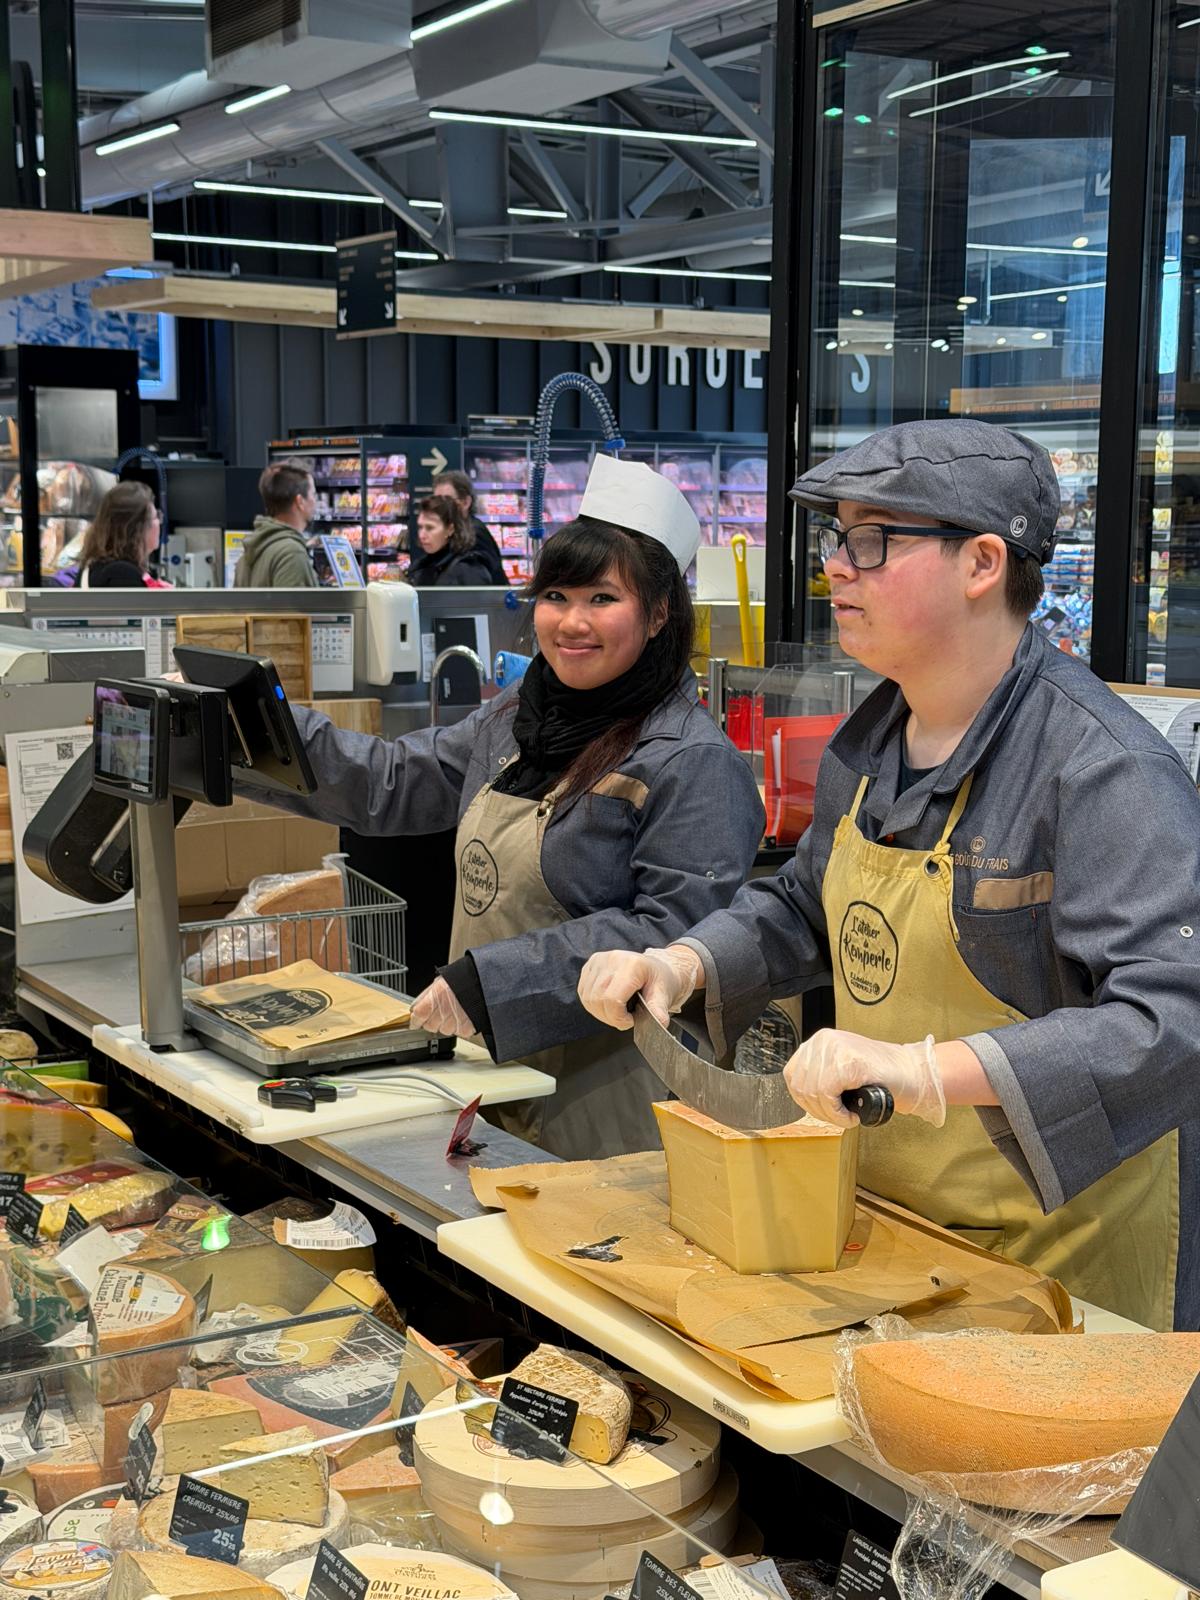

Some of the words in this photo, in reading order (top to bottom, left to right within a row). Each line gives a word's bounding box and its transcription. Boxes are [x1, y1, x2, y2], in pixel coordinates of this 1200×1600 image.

[971, 855, 986, 868] DU
[985, 857, 1009, 870] FRAIS
[96, 1269, 120, 1302] Catalane
[112, 1275, 132, 1303] Tomme
[186, 1481, 210, 1498] TOMME
[644, 1556, 665, 1578] TOMME
[664, 1575, 678, 1589] DES
[370, 1579, 401, 1593] ONT
[405, 1586, 461, 1599] VEILLAC
